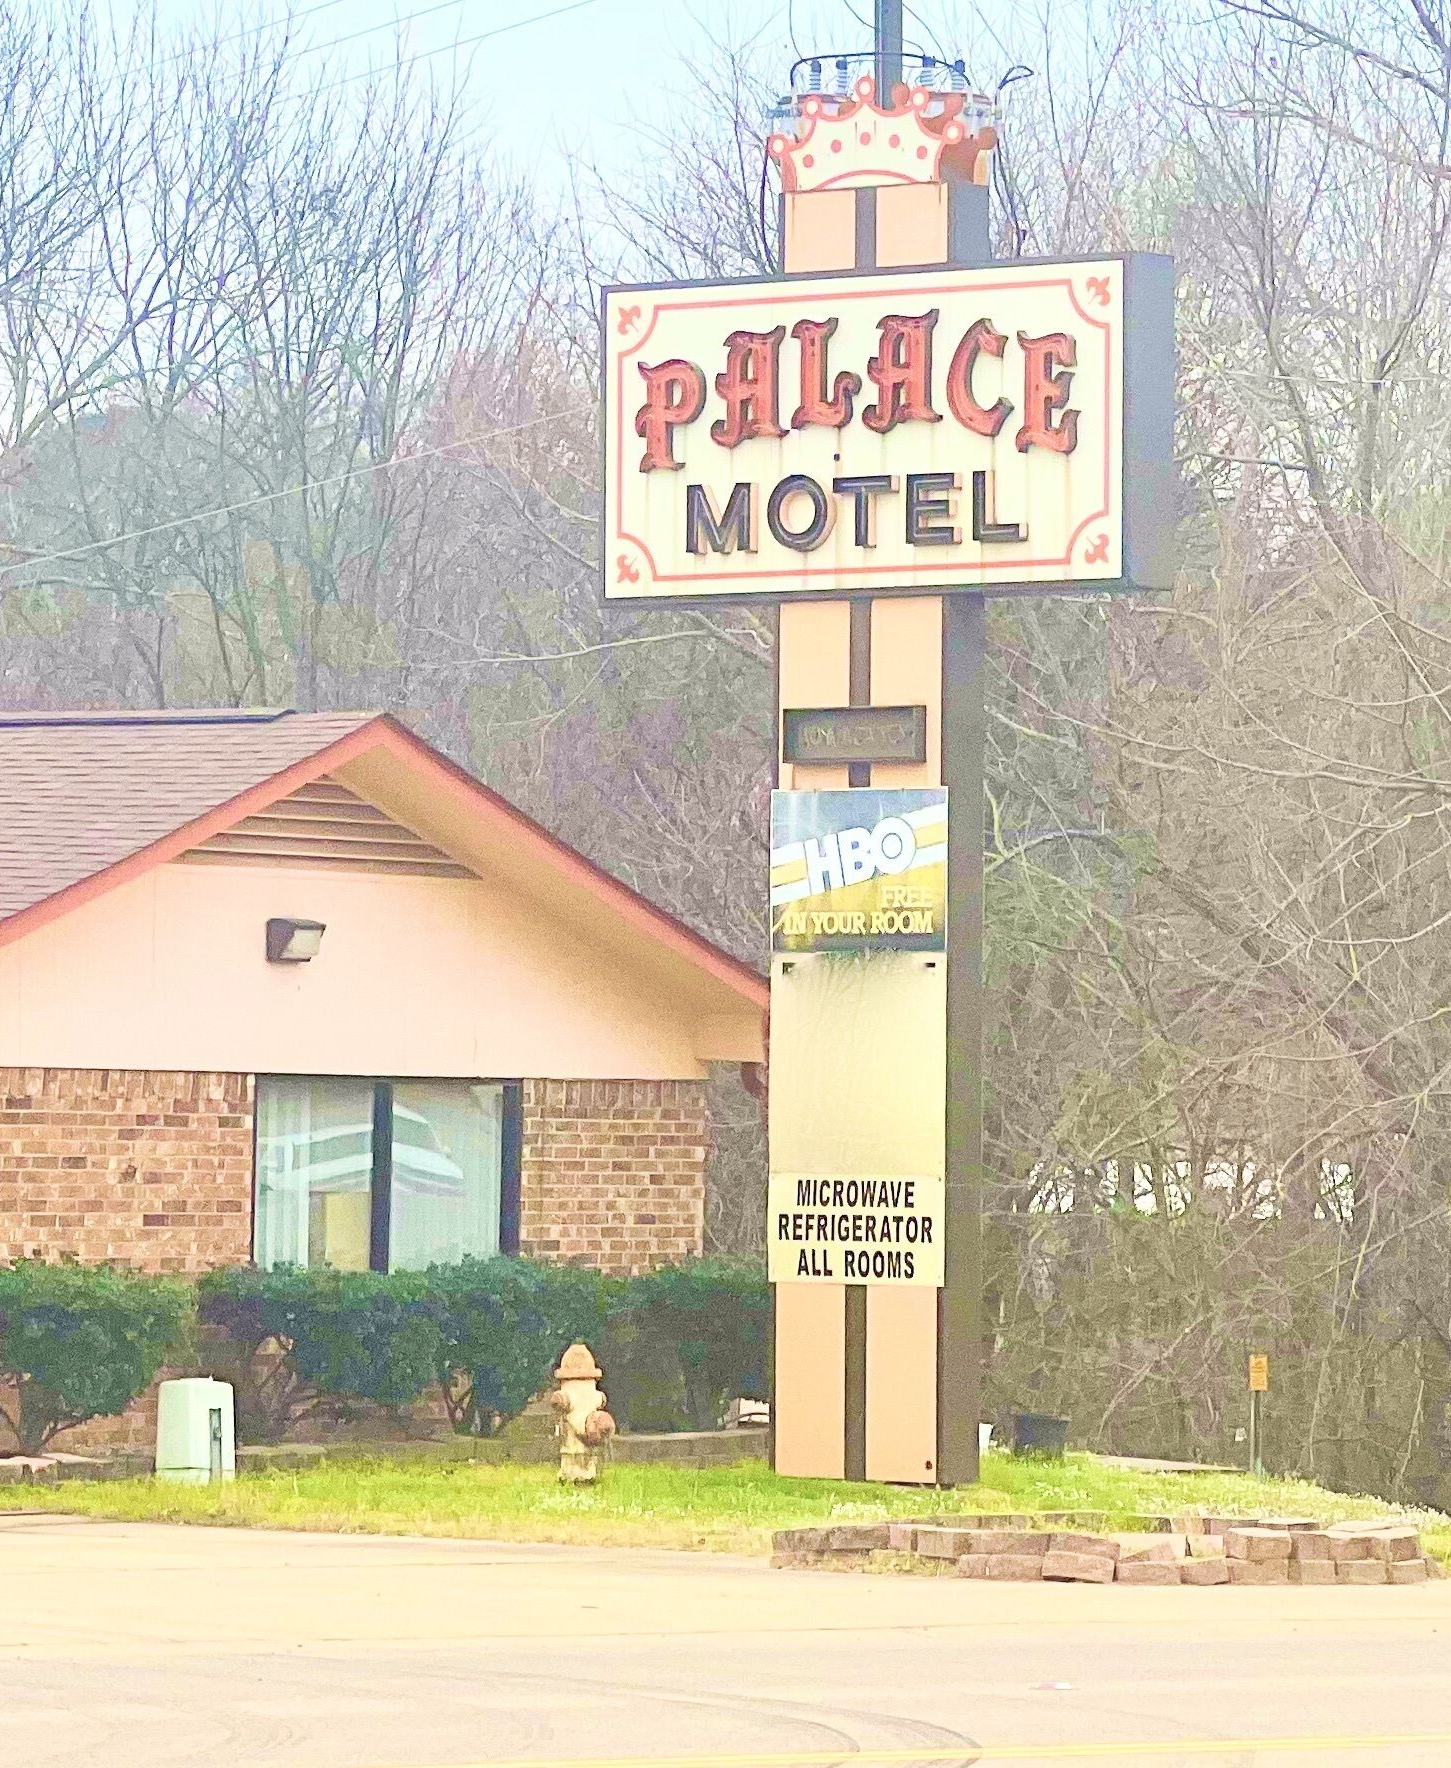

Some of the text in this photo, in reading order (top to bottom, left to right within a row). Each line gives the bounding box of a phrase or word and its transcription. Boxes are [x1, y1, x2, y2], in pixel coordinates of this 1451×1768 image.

[635, 308, 1082, 474] PALACE
[686, 470, 1029, 555] MOTEL
[803, 816, 917, 896] HBO
[881, 886, 934, 908] FREE
[783, 910, 934, 935] IN YOUR ROOM
[796, 1179, 915, 1209] MICROWAVE
[778, 1213, 933, 1243] REFRIGERATOR
[797, 1249, 915, 1279] ALL ROOMS
